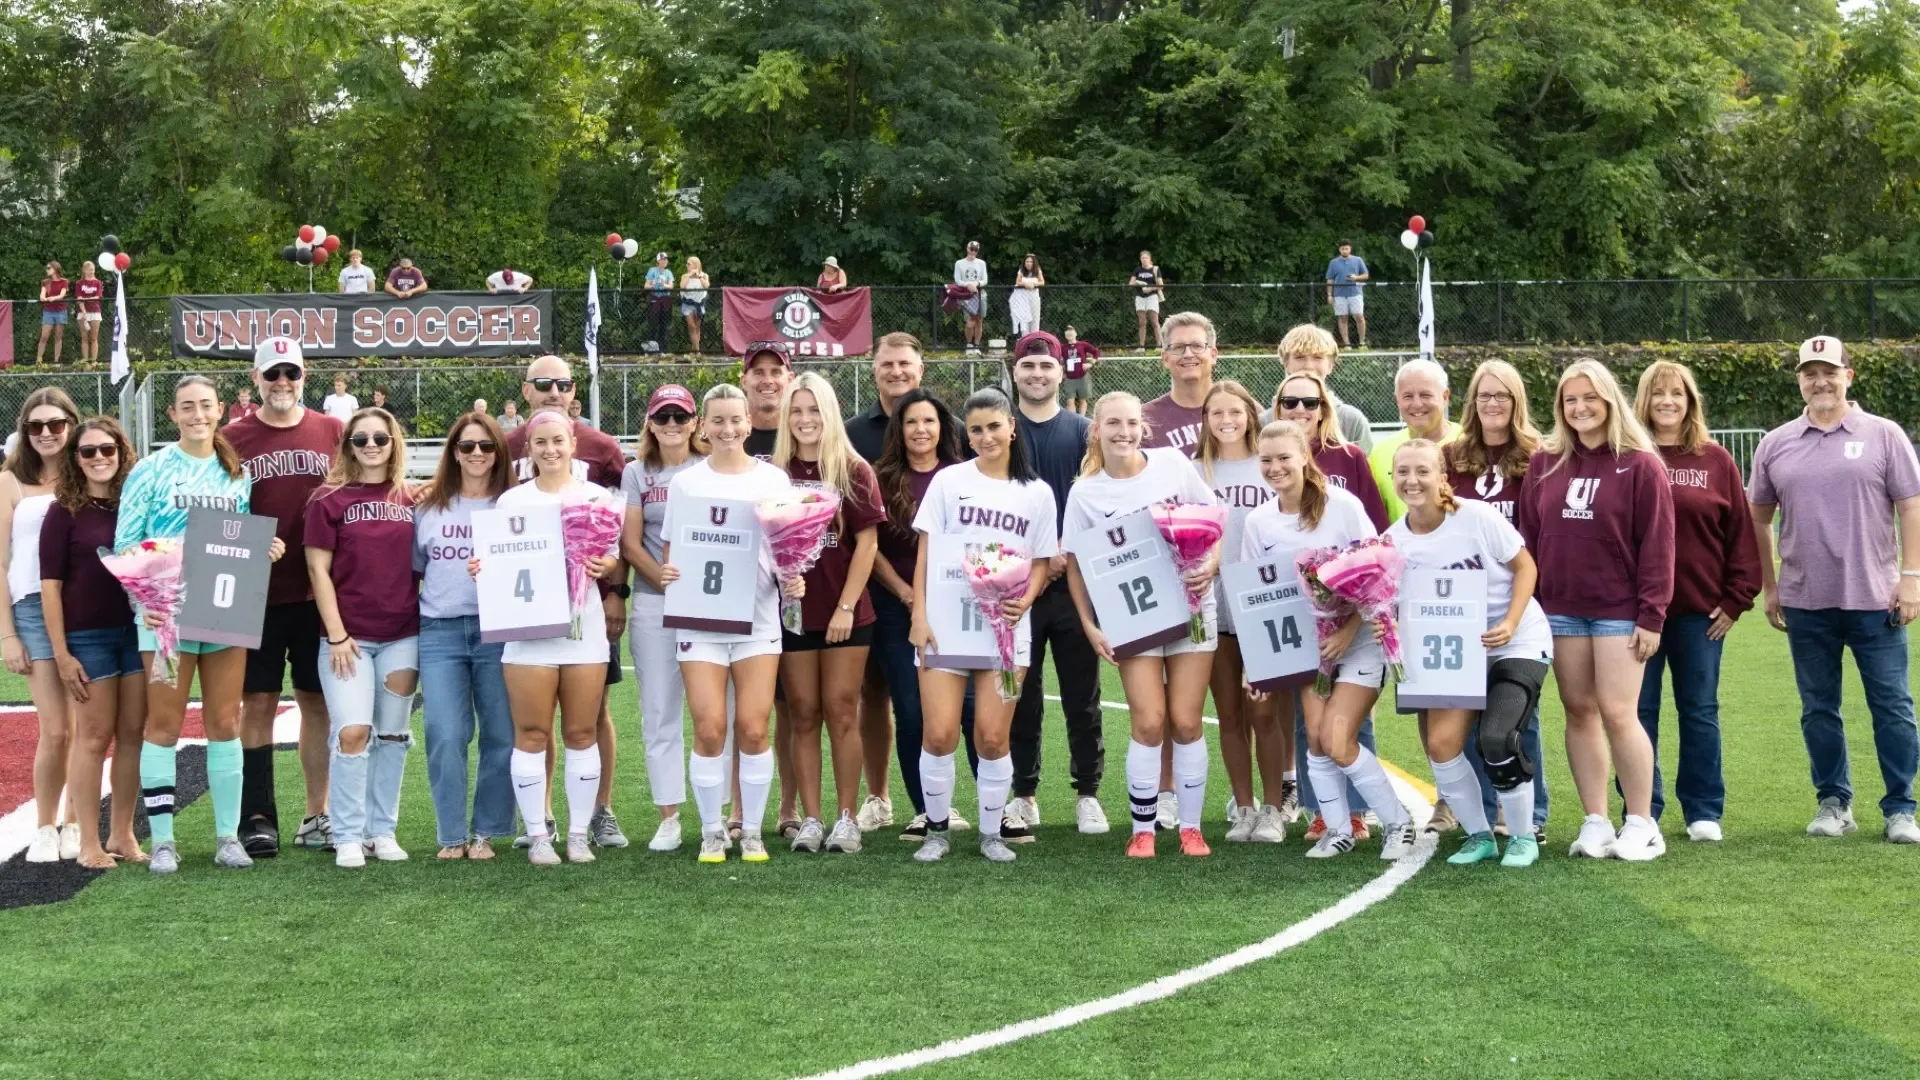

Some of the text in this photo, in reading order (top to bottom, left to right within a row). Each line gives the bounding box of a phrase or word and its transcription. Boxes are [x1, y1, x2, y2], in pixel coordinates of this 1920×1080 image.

[784, 293, 810, 304] UNION
[790, 306, 806, 324] U
[182, 308, 338, 351] UNION
[353, 305, 541, 348] SOCCER
[782, 326, 813, 338] COLLEGE
[274, 341, 289, 354] U
[785, 341, 845, 356] CCER
[243, 450, 330, 485] UNION
[1668, 468, 1708, 489] ION
[174, 495, 238, 512] UNION
[1213, 484, 1276, 508] NION
[344, 501, 415, 525] UNION
[708, 505, 729, 526] U
[958, 505, 1031, 538] UNION
[1561, 508, 1594, 520] SOCCER
[222, 519, 242, 540] U
[441, 525, 473, 539] UNI
[509, 516, 526, 535] U
[1106, 524, 1127, 548] U
[489, 539, 548, 555] CUTICELLI
[691, 531, 740, 545] BOVARDI
[205, 543, 251, 560] KOSTER
[431, 546, 475, 561] SOC
[1108, 549, 1140, 568] SAMS
[702, 560, 724, 596] 8
[1257, 563, 1278, 585] U
[212, 573, 236, 609] 0
[513, 568, 535, 603] 4
[1118, 575, 1158, 616] 12
[1247, 586, 1299, 606] SHELDON
[1434, 577, 1453, 599] U
[1420, 606, 1464, 617] PASEKA
[1263, 615, 1302, 654] 14
[1422, 634, 1463, 670] 33
